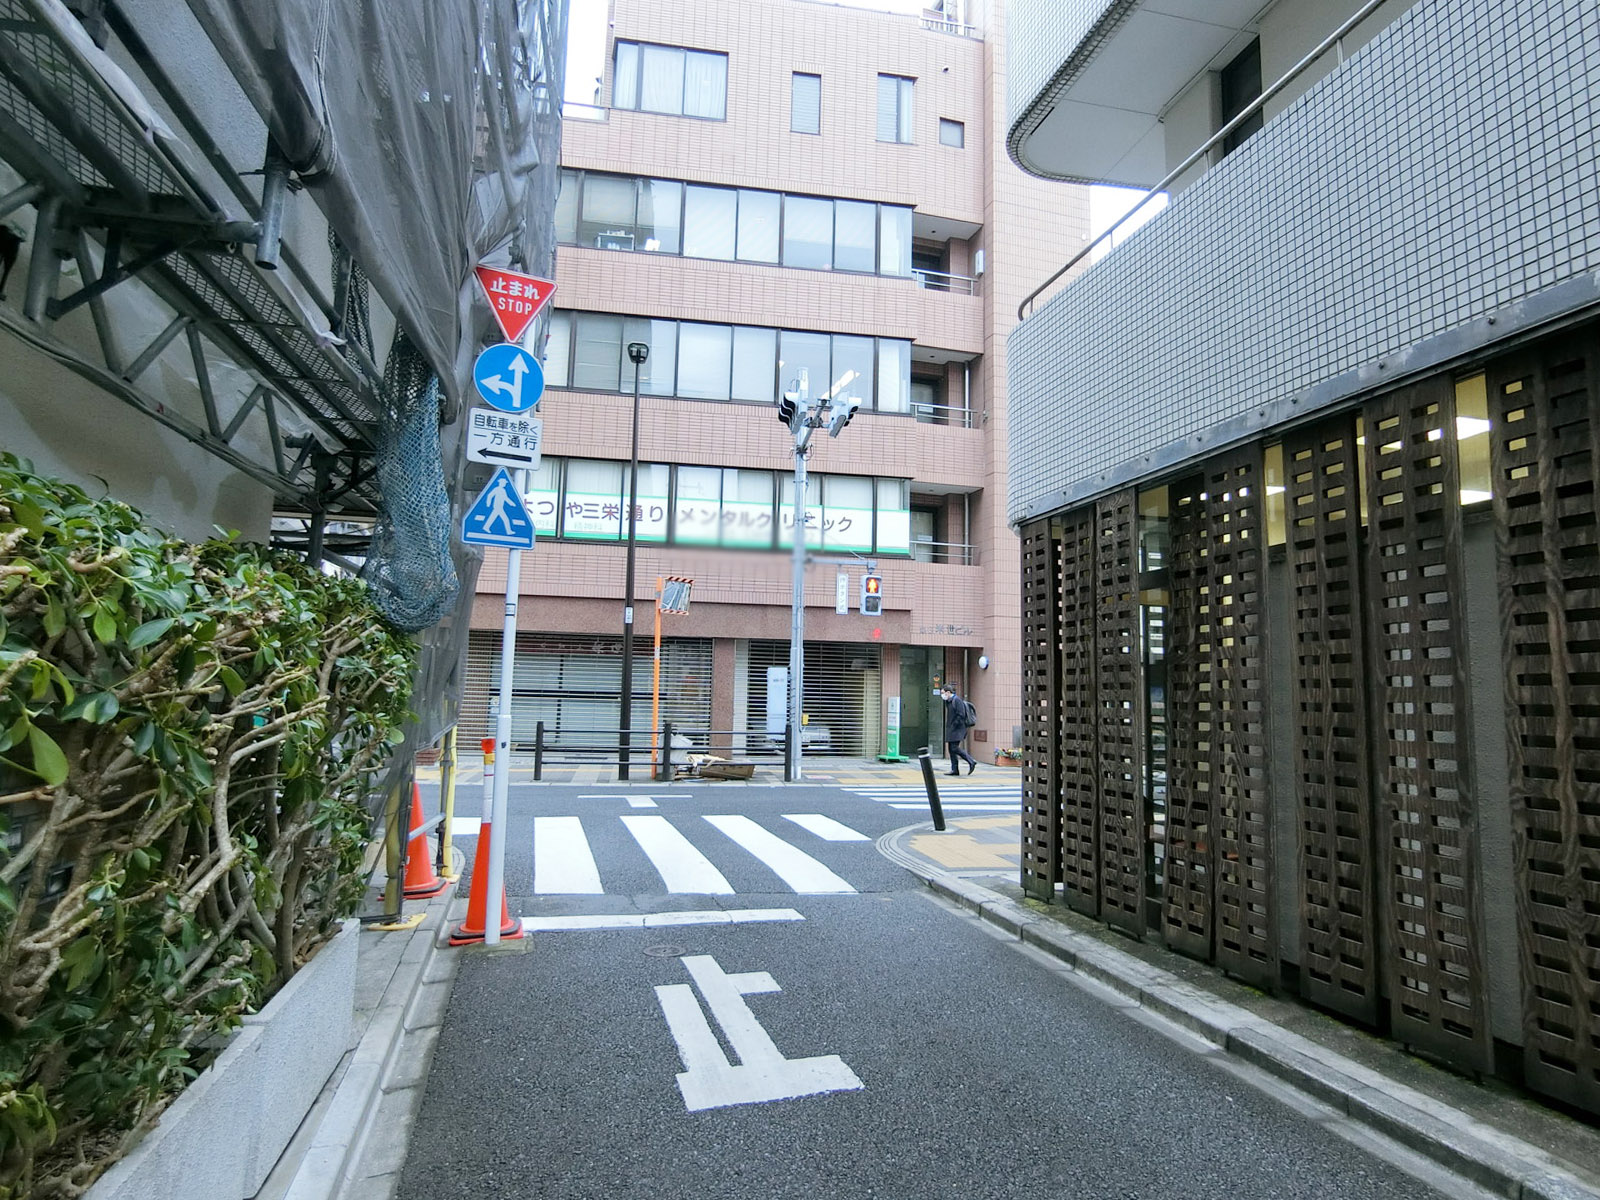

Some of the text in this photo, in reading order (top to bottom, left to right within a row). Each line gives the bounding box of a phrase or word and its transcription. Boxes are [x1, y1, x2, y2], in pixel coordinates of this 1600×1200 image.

[490, 278, 540, 300] 止まれ
[498, 297, 532, 314] STOP
[474, 414, 538, 435] 自転車を除く
[473, 433, 538, 451] 一方通行
[653, 954, 866, 1112] 止
